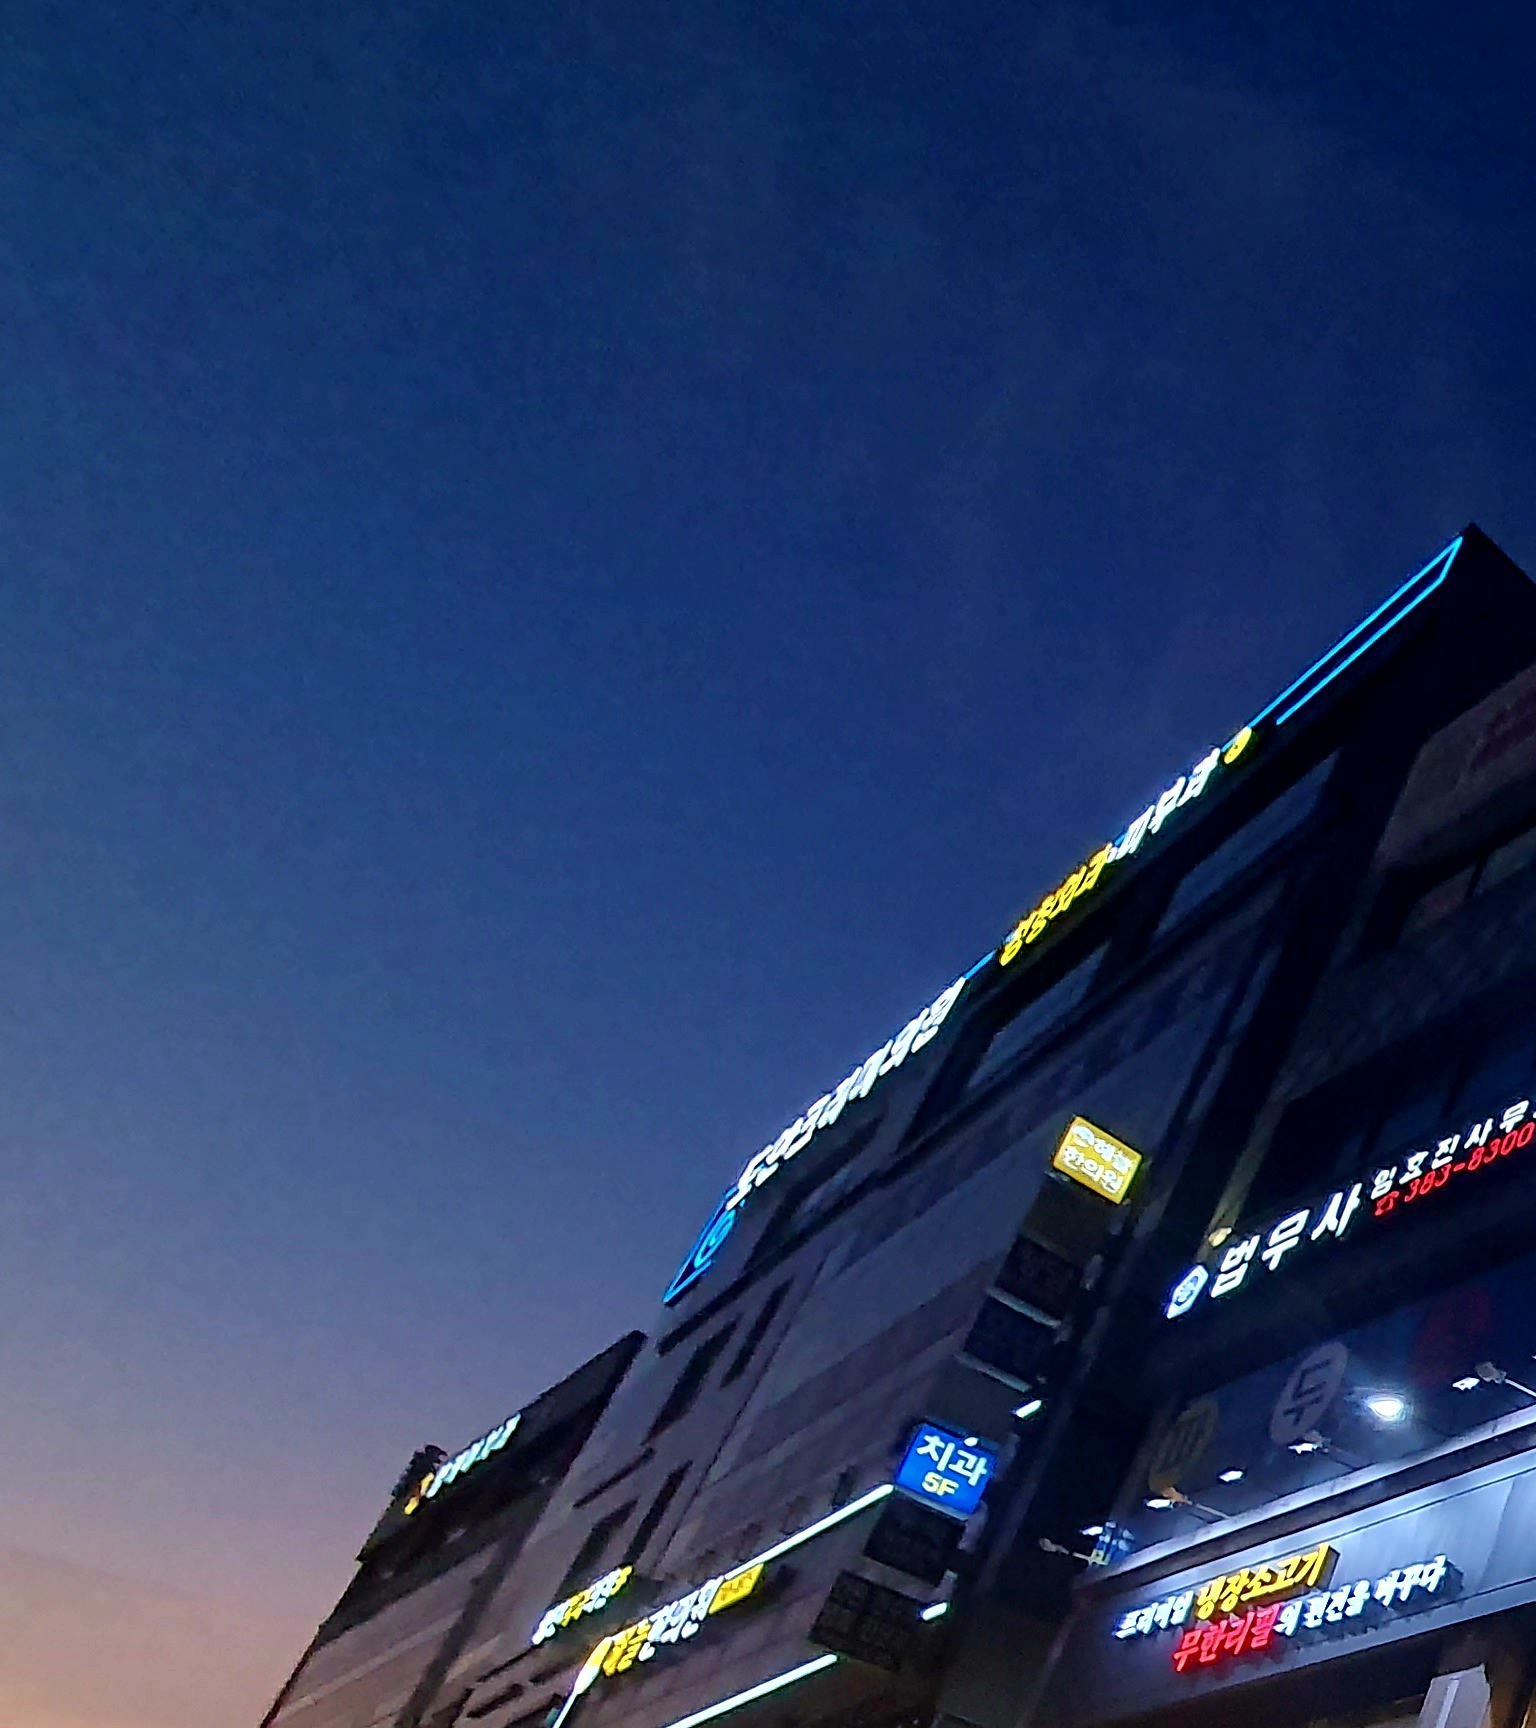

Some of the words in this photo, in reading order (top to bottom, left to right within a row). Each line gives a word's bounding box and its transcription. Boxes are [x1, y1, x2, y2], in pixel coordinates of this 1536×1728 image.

[1404, 1121, 1536, 1203] 383-8300
[1209, 1181, 1363, 1299] 법무사
[916, 1434, 988, 1486] 치과
[1194, 1542, 1331, 1621] 냉장소고기
